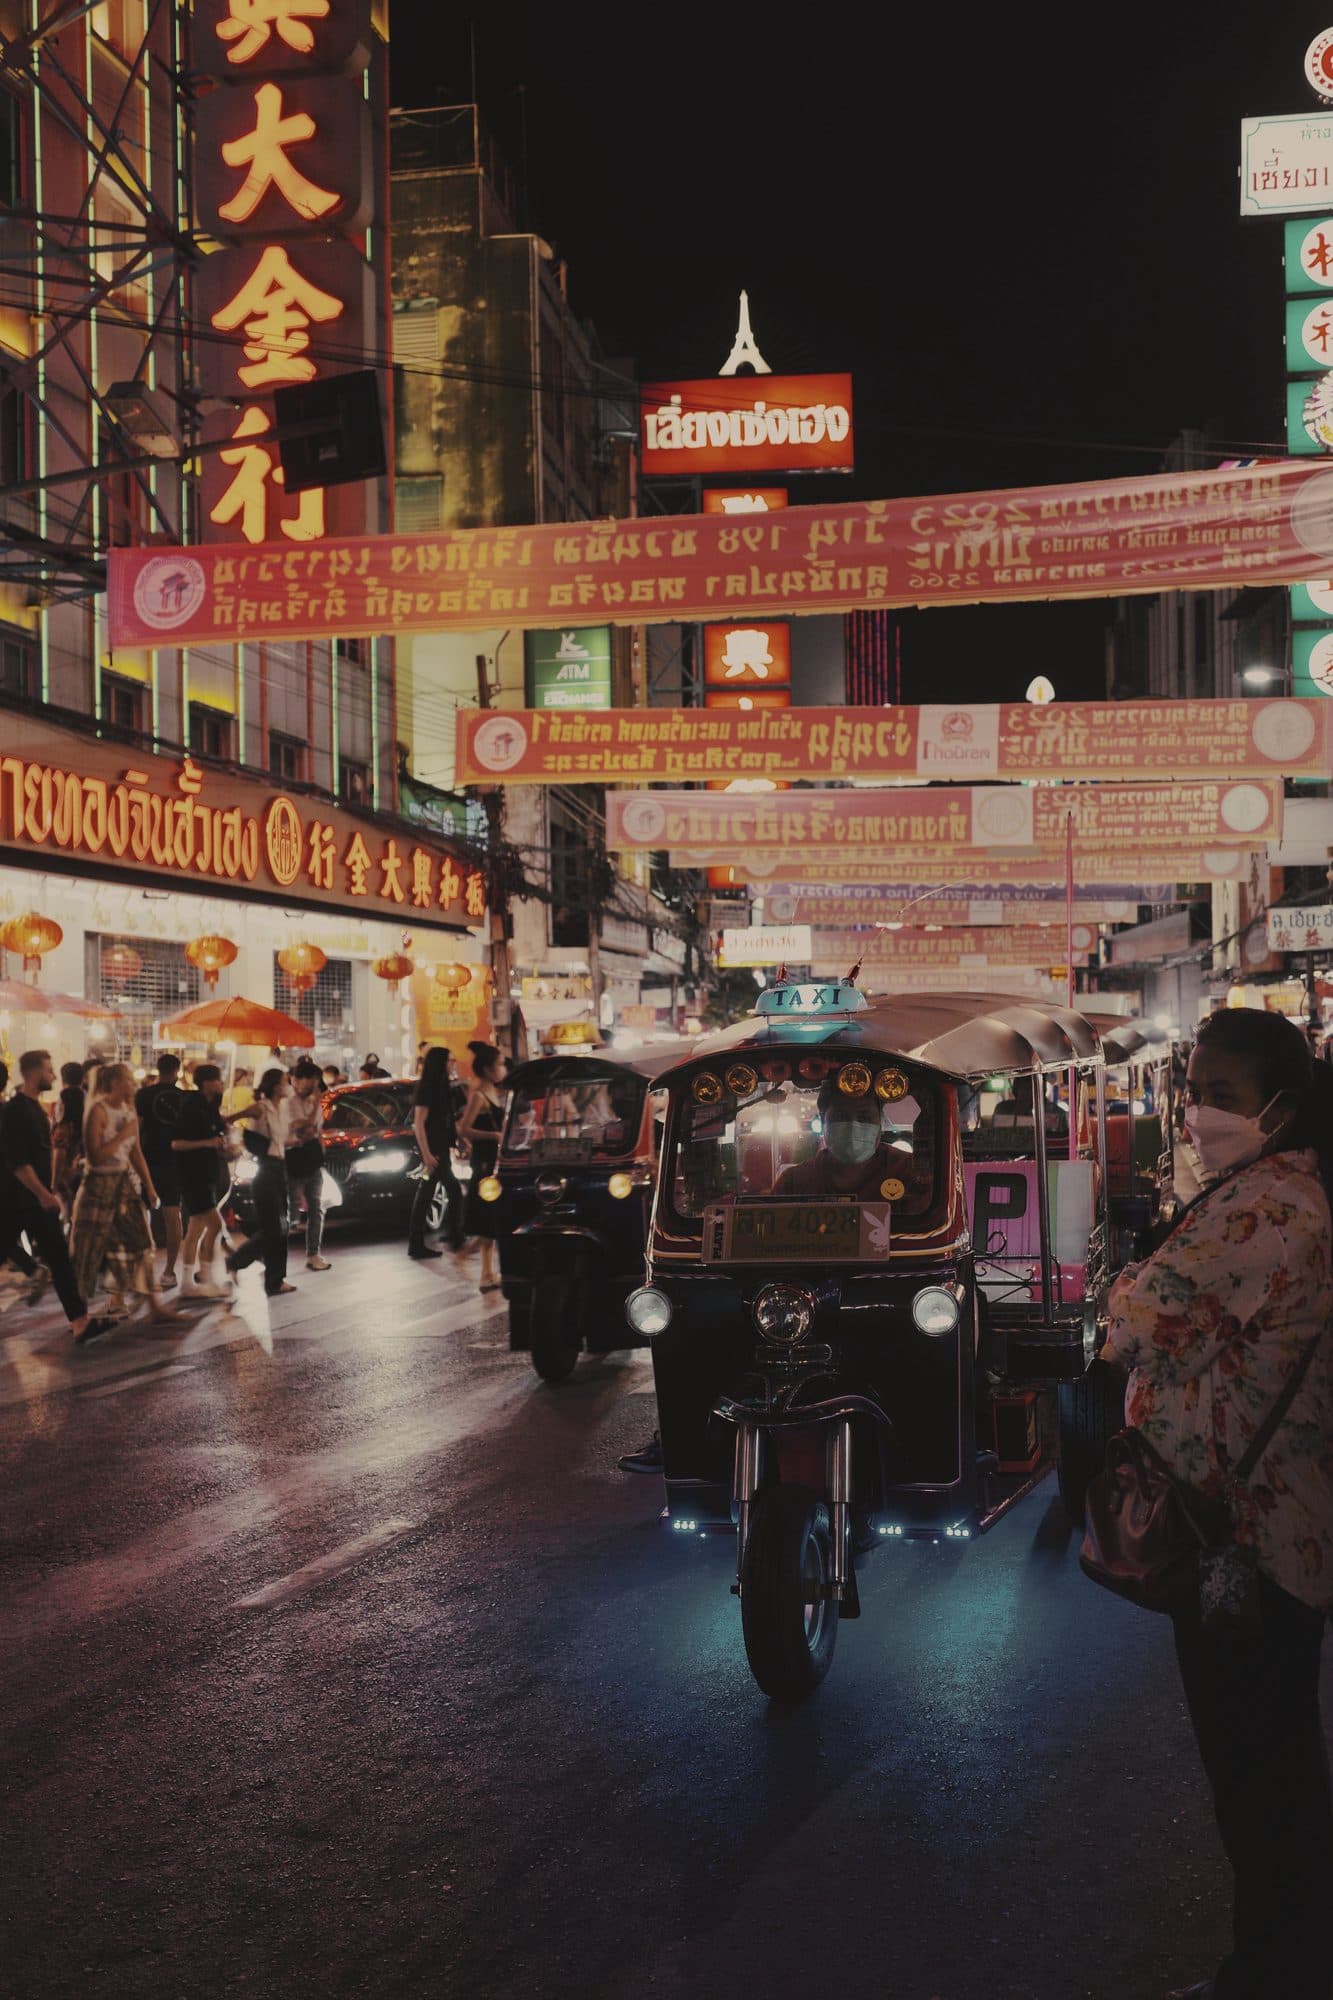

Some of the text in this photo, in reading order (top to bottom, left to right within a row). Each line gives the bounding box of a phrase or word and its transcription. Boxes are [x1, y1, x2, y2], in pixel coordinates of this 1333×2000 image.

[556, 663, 590, 680] ATM
[0, 757, 258, 881] ายทองจินฮั้วเฮง
[774, 988, 840, 1007] TAXI
